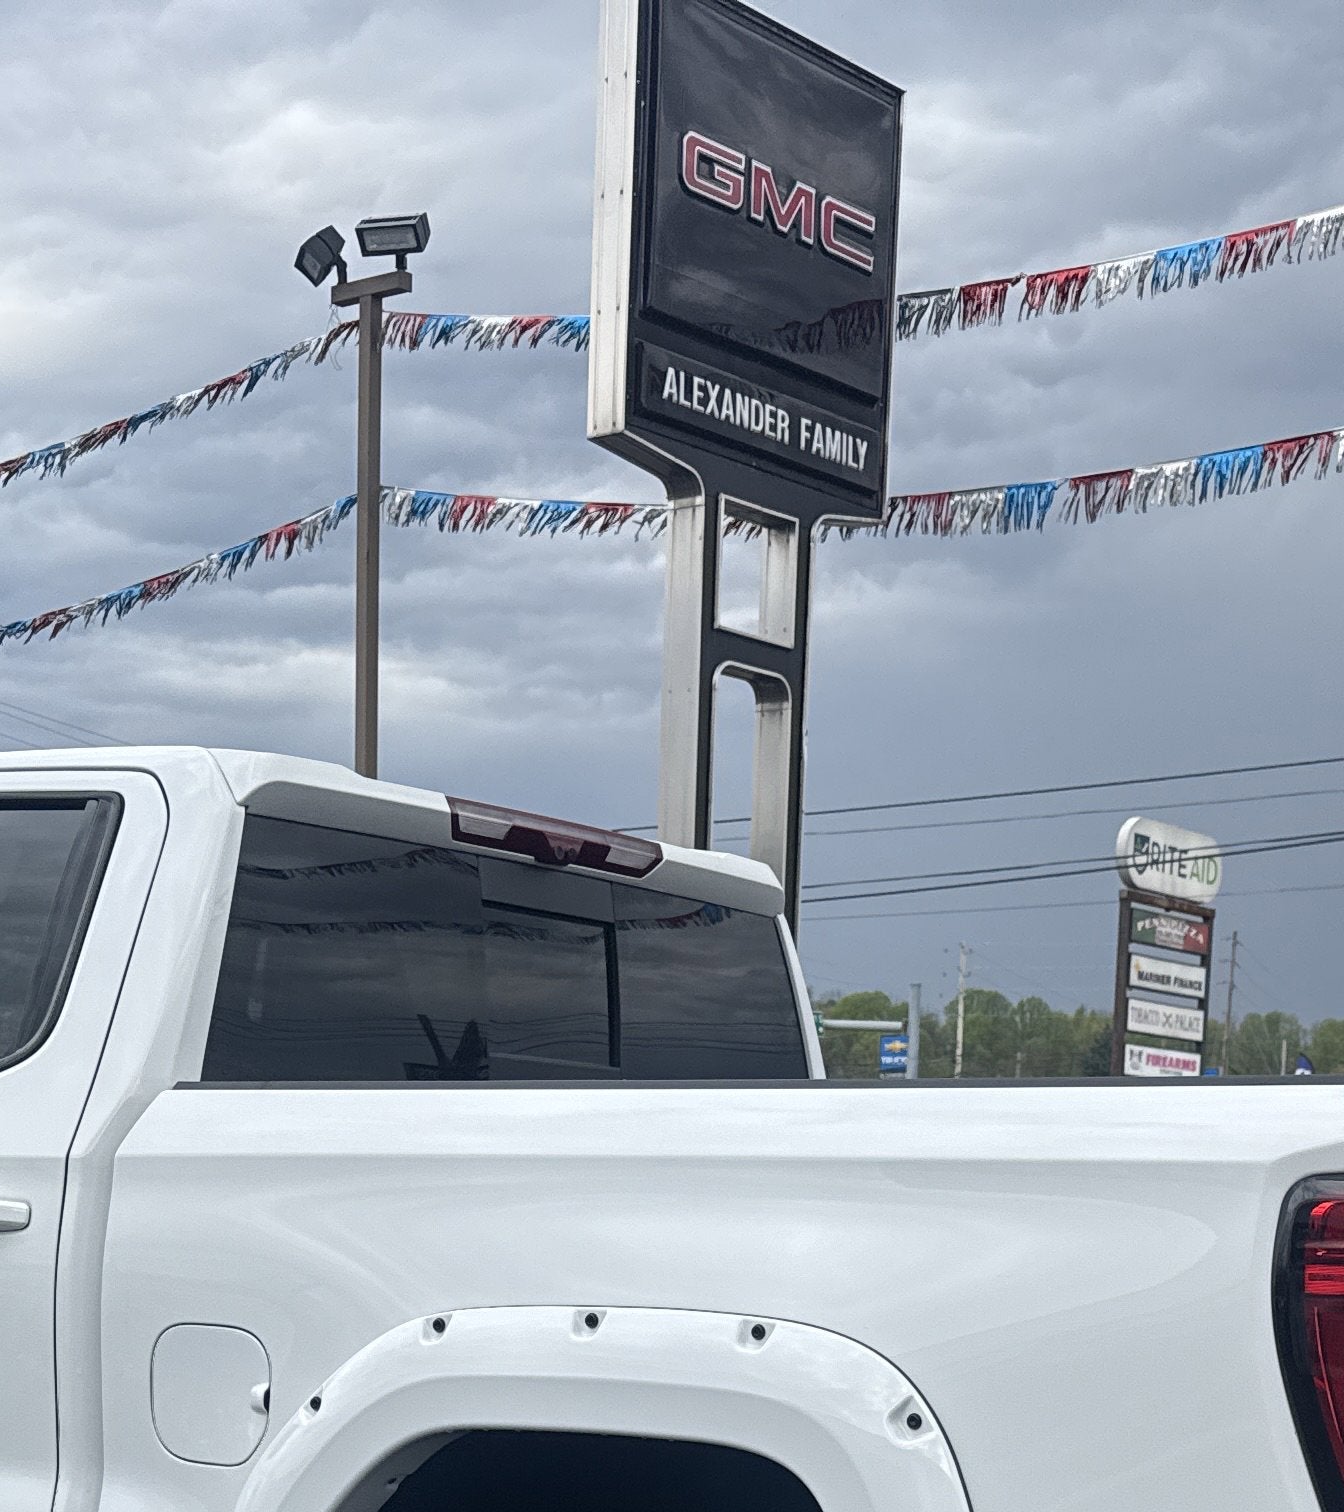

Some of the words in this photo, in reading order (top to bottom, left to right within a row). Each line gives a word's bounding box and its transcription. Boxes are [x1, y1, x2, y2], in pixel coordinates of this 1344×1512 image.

[682, 130, 876, 273] GMC
[662, 366, 790, 446] ALEXANDER
[799, 416, 869, 472] FAMILY
[1150, 841, 1189, 879] RITE
[1190, 856, 1218, 885] AID
[1146, 1053, 1197, 1073] FIREARMS
